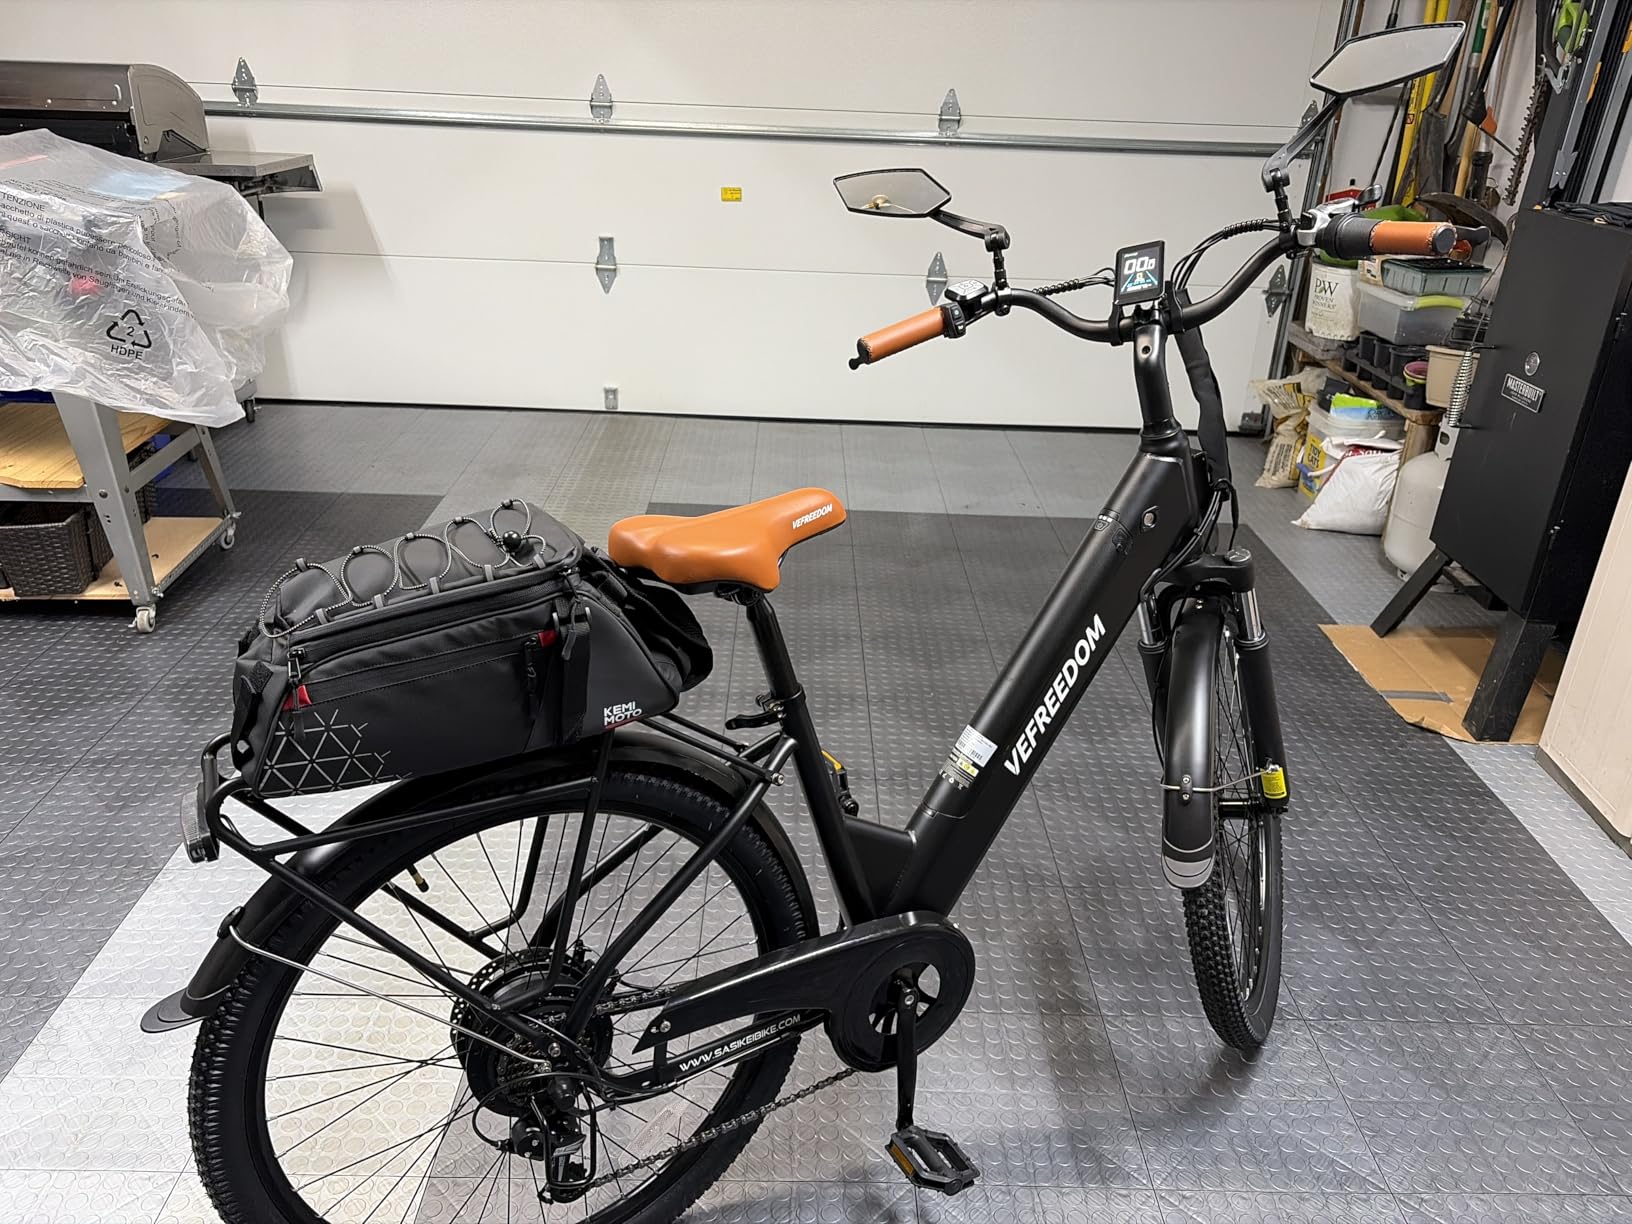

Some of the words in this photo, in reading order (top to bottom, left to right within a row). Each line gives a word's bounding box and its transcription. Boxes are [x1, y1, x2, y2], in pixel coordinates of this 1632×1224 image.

[126, 326, 135, 337] 2
[110, 343, 144, 360] HDPE
[792, 503, 833, 530] VEFREEDOM
[1003, 613, 1107, 776] VEFREEDOM
[604, 701, 636, 717] KEMI
[604, 709, 642, 726] MOTO
